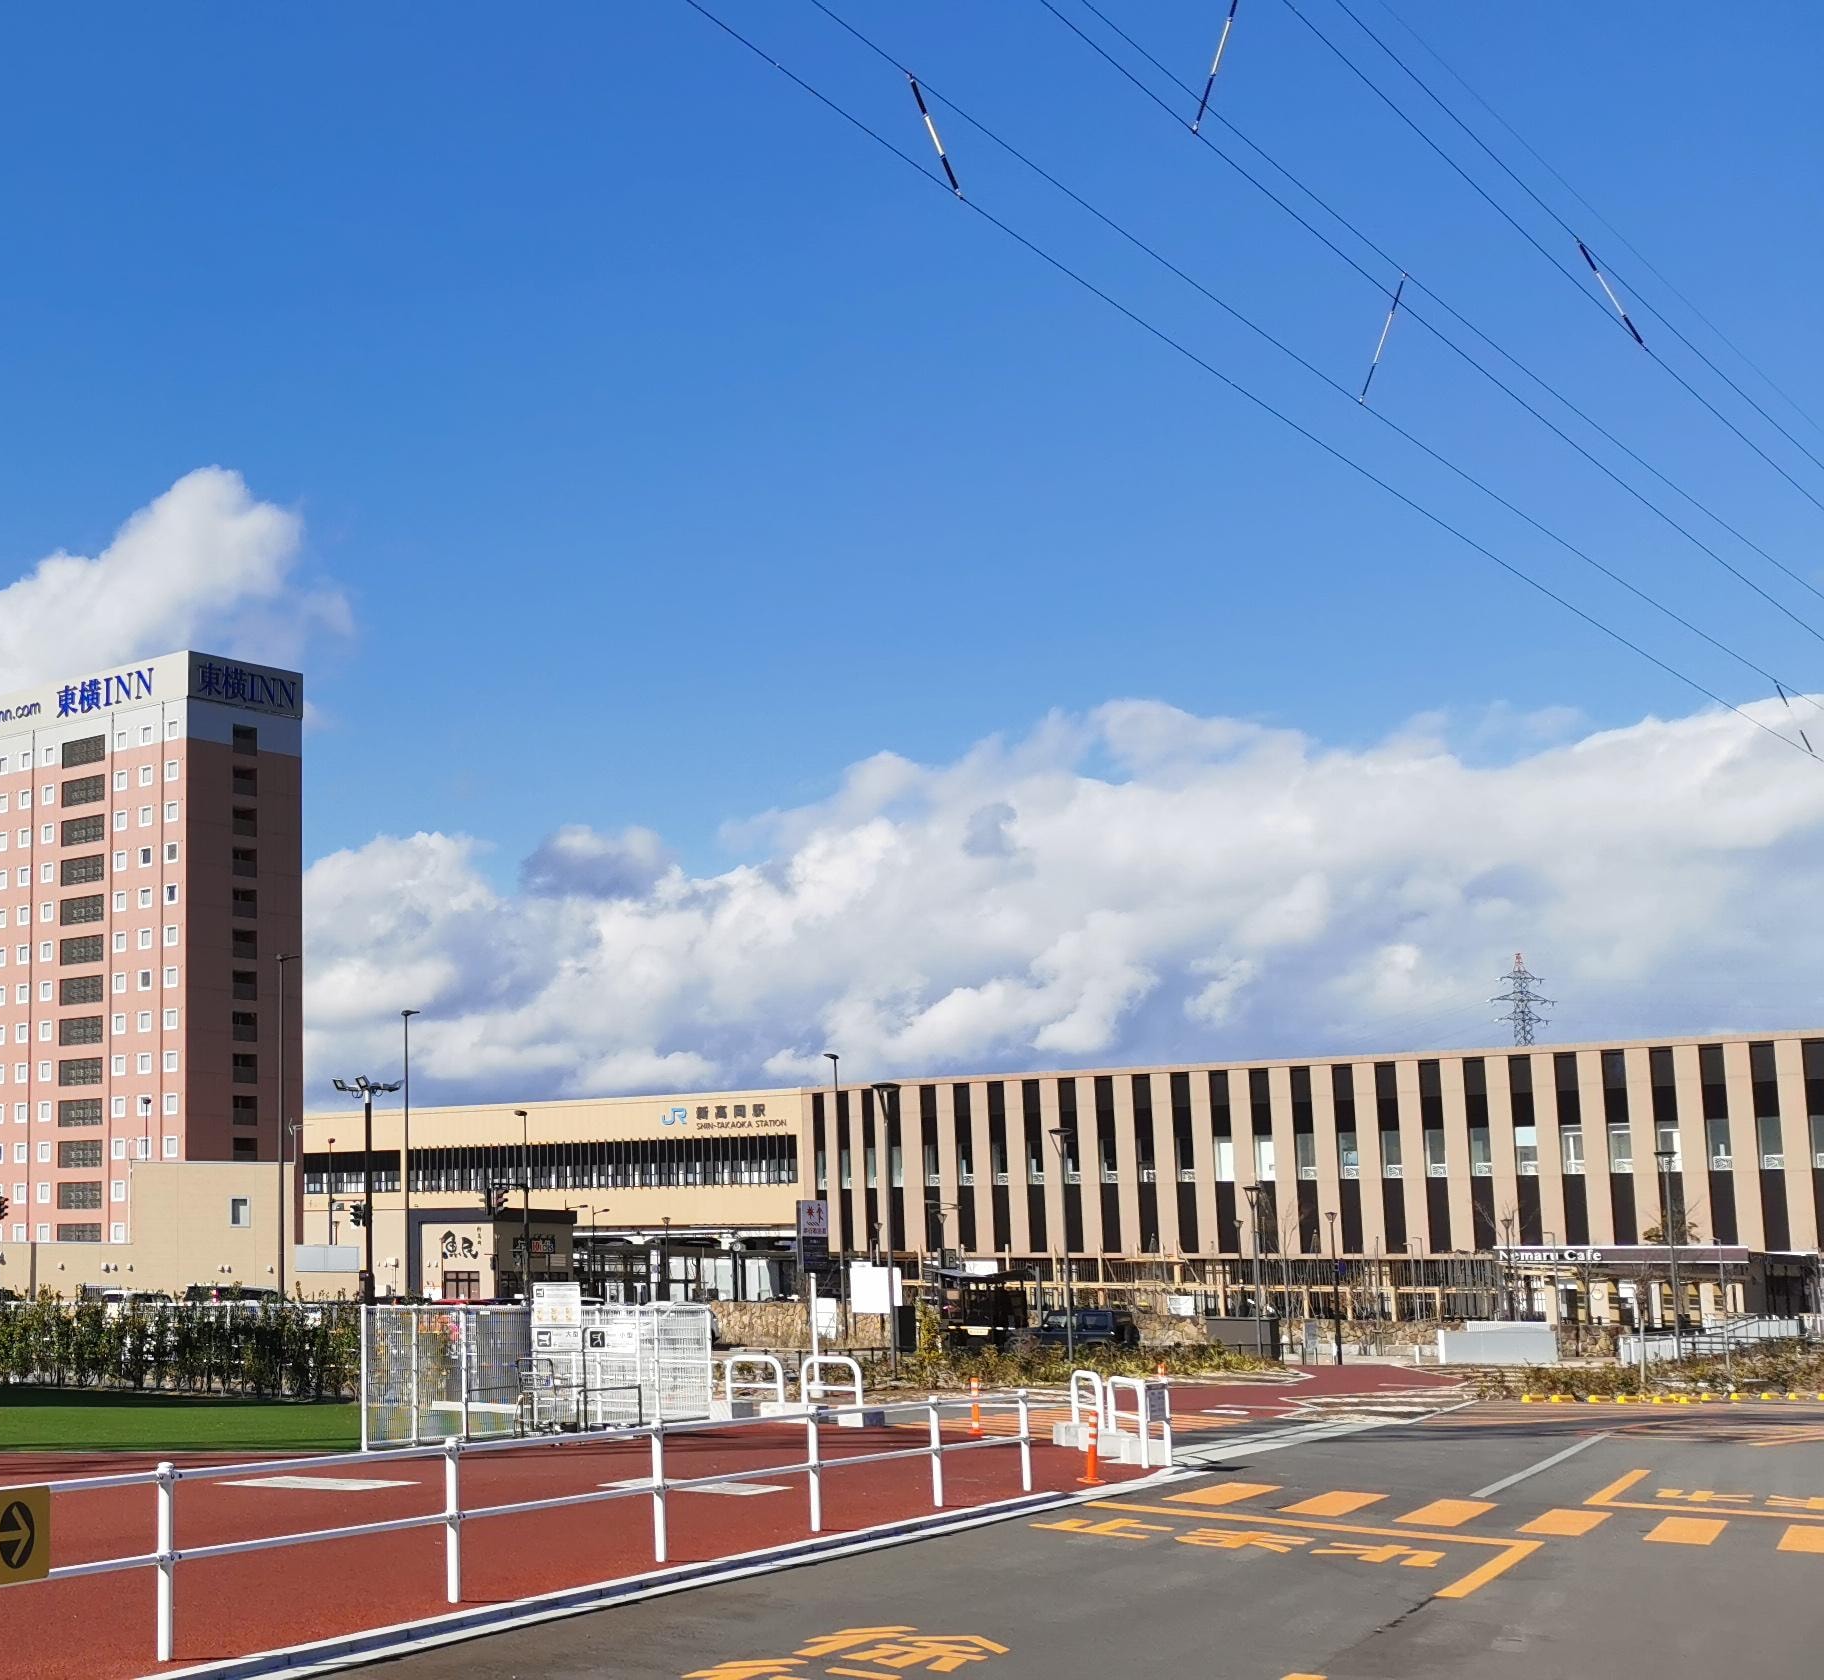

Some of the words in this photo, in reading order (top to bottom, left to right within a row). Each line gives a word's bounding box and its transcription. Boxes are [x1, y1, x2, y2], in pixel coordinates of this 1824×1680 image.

[56, 668, 154, 718] 東横INN
[197, 662, 297, 710] 東横INN
[661, 1107, 688, 1126] JR
[695, 1104, 766, 1121] 新高岡駅
[755, 1119, 787, 1128] STATION
[1564, 1249, 1602, 1262] Cafe
[1028, 1518, 1447, 1568] 止まれ
